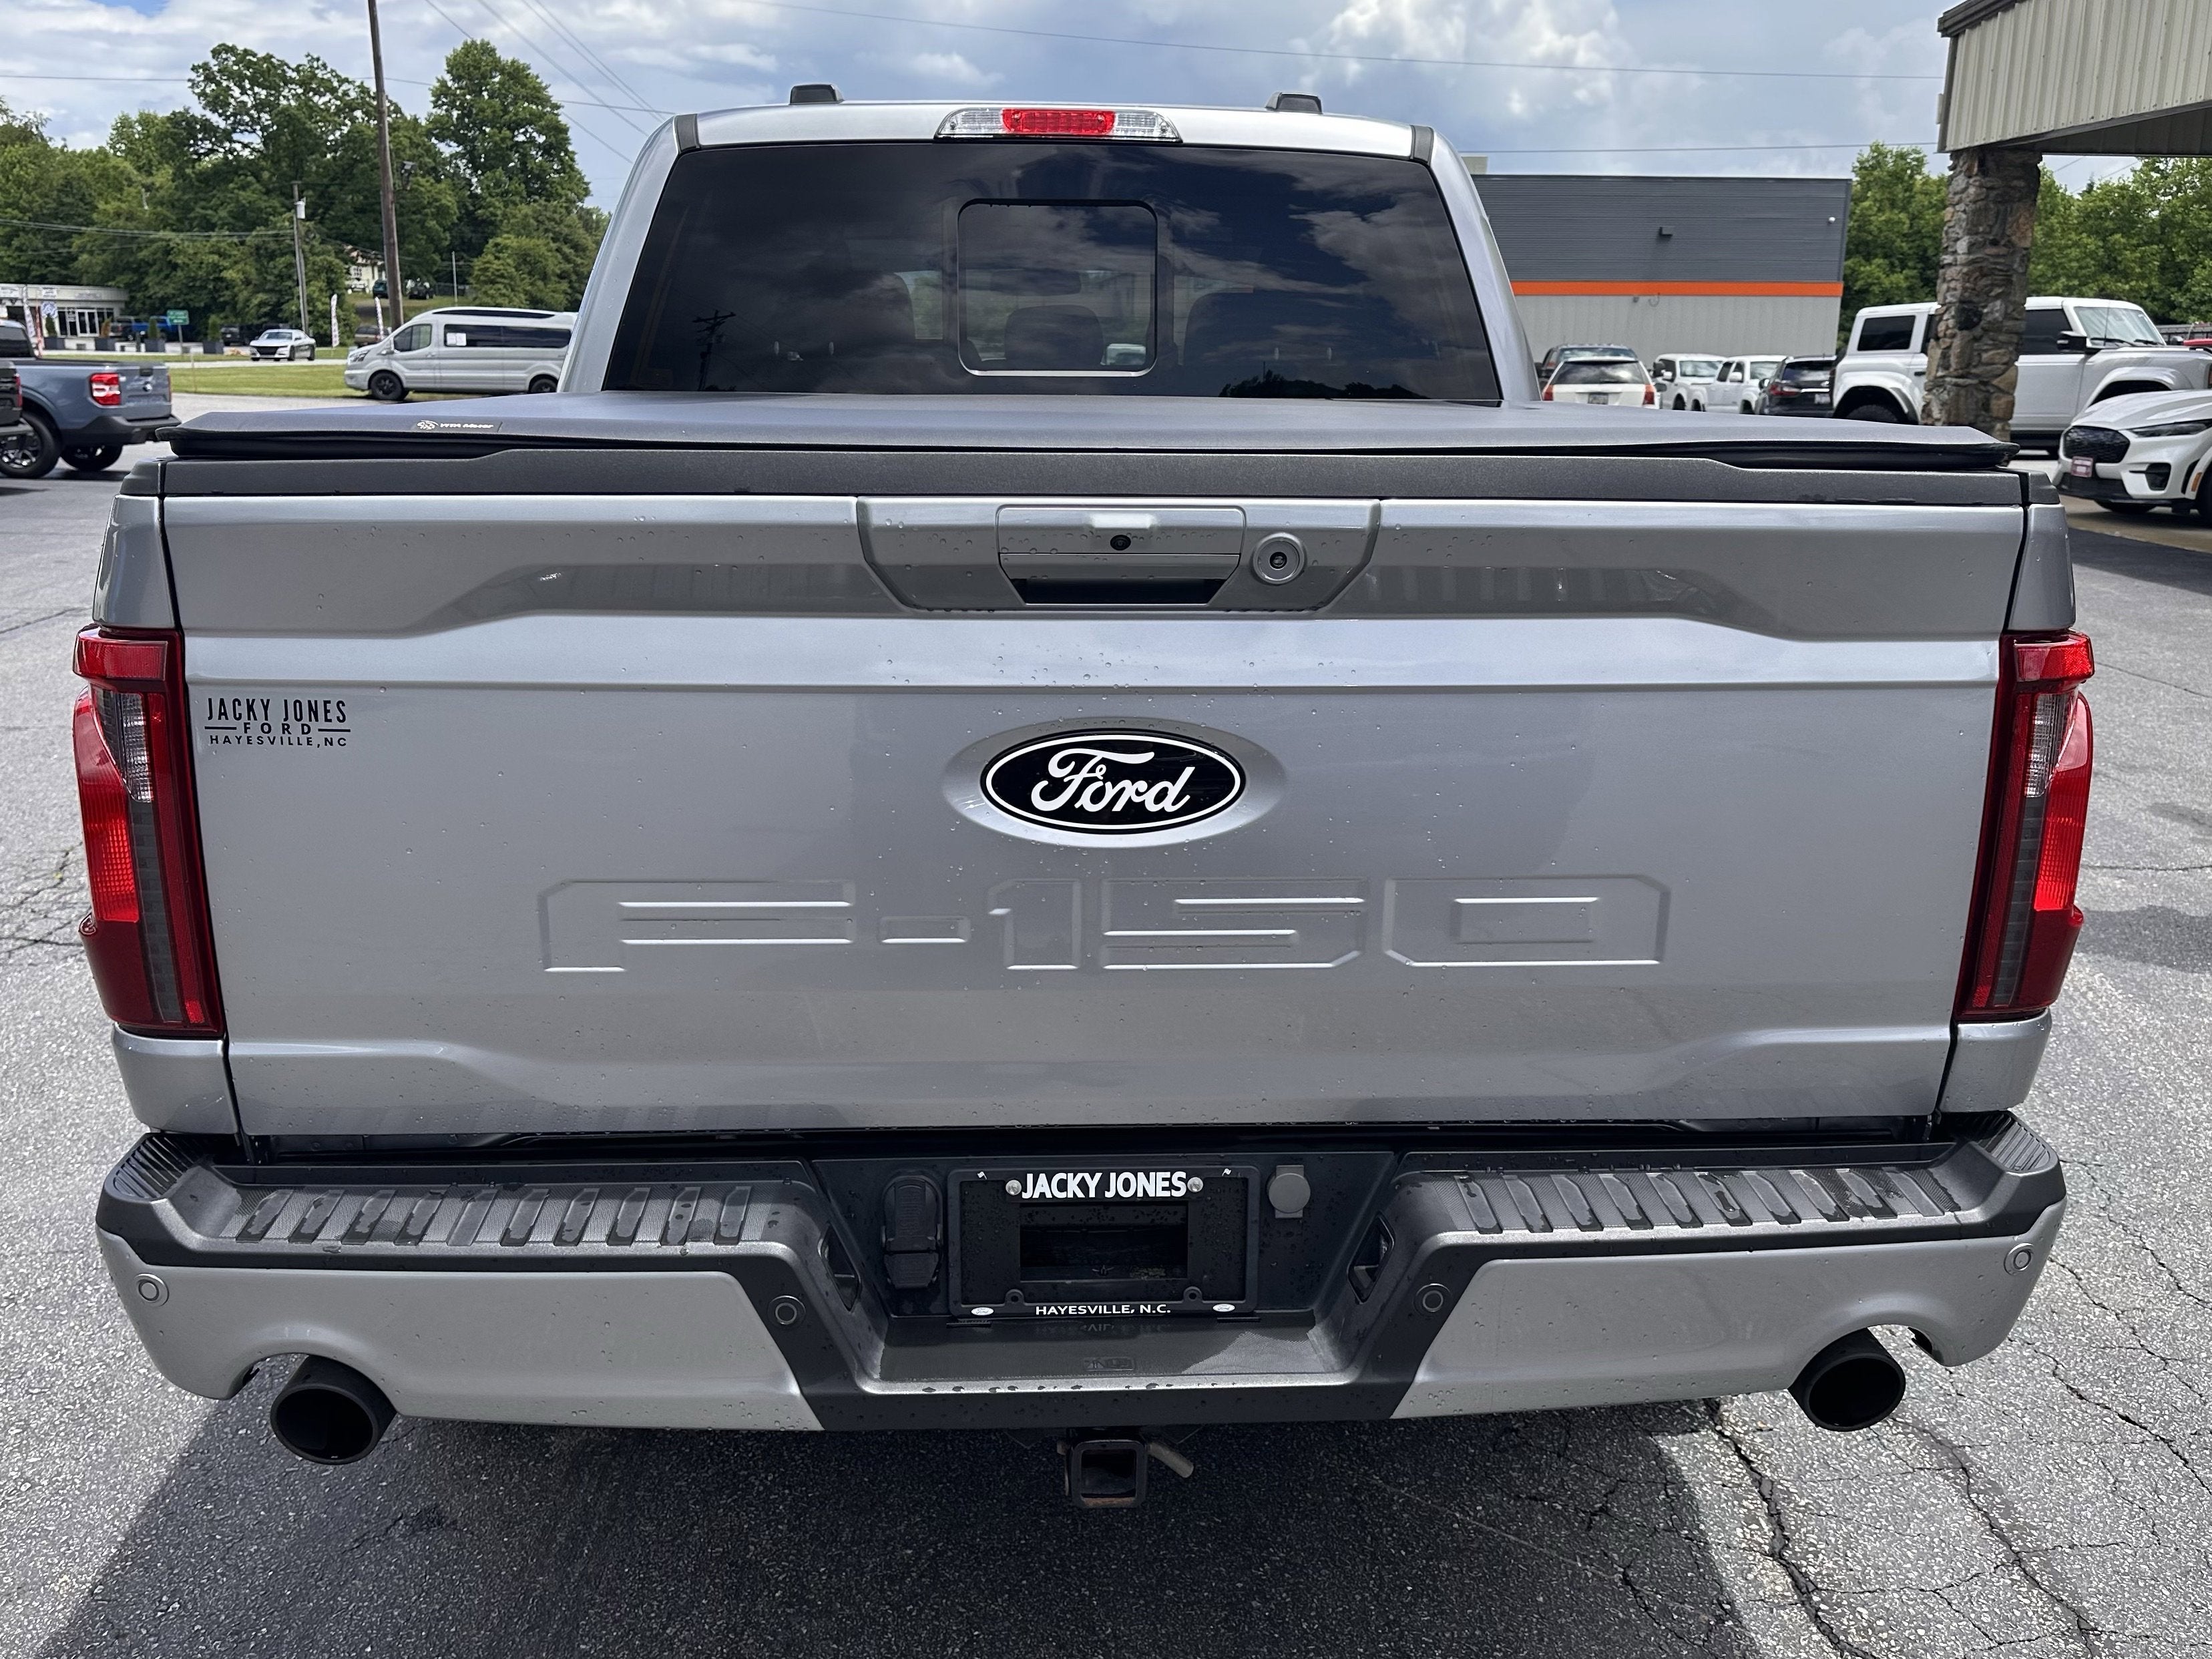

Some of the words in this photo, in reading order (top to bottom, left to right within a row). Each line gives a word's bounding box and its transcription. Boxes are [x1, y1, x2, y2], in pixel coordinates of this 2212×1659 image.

[208, 698, 270, 721] JACKY
[283, 699, 347, 723] JONES
[243, 722, 312, 735] FORD
[1031, 748, 1195, 812] Ford
[537, 875, 1670, 972] F-150
[1022, 1172, 1102, 1199] JACKY
[1104, 1171, 1187, 1198] JONES
[1036, 1305, 1135, 1315] HAYESVILLE,
[1140, 1304, 1171, 1314] N.C.
